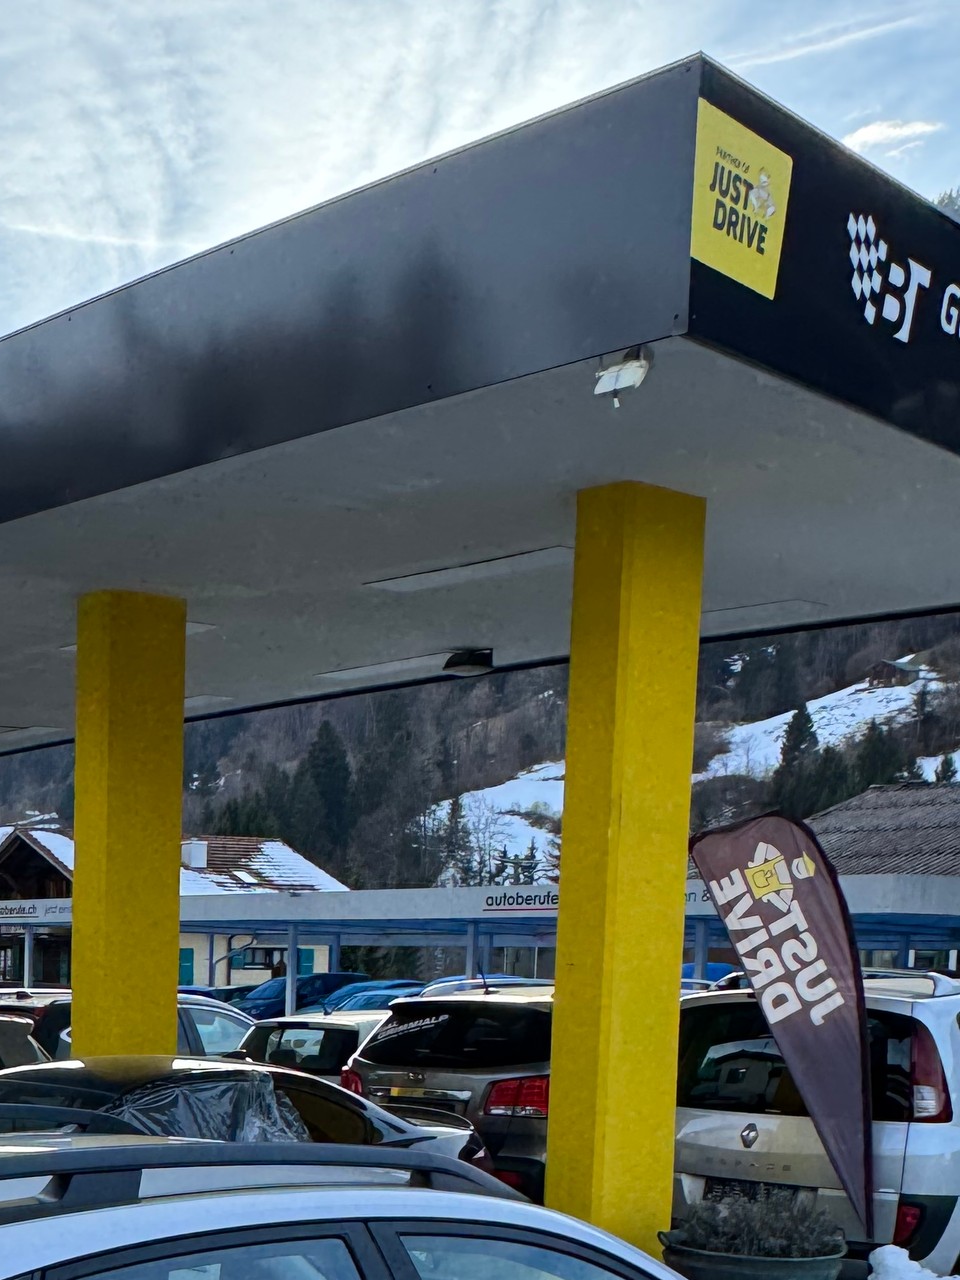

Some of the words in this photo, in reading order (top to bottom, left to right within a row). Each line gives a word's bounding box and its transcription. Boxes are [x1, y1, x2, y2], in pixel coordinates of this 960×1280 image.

[709, 161, 754, 210] JUST
[712, 198, 768, 255] DRIVE
[940, 283, 960, 338] G
